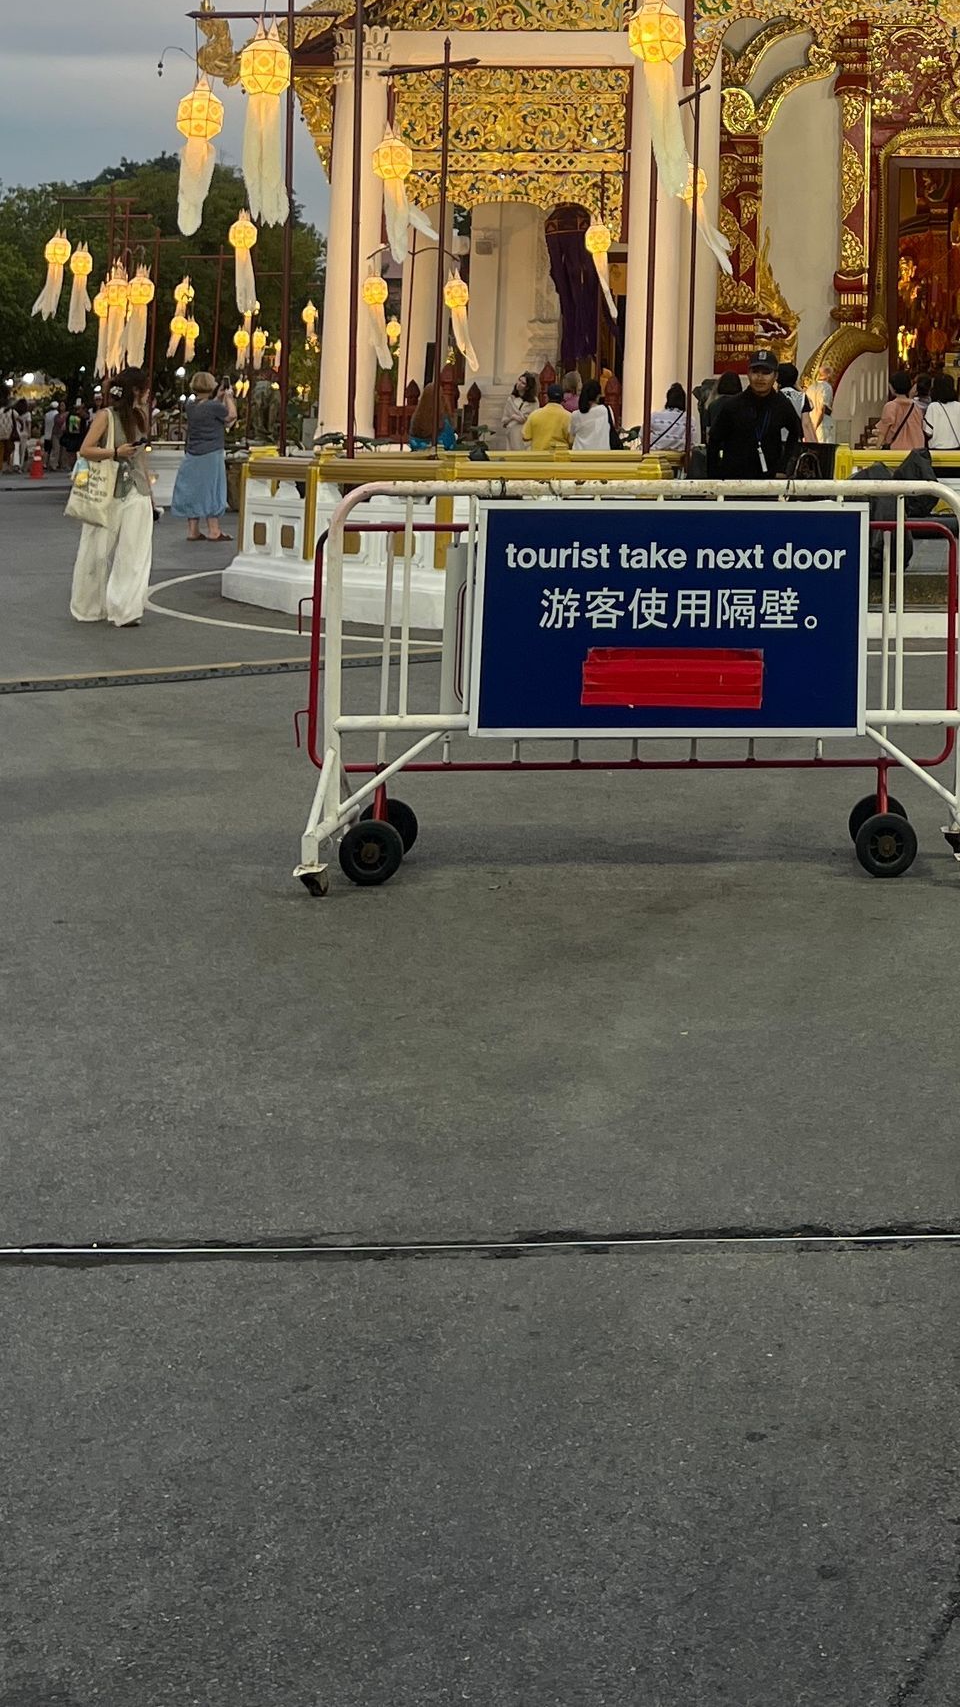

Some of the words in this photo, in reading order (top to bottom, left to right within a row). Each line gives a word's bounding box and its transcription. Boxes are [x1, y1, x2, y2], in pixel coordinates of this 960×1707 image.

[505, 541, 610, 569] tourist
[618, 541, 688, 569] take
[696, 545, 765, 570] next
[772, 542, 847, 570] door
[538, 586, 819, 630] 游客使用隔壁。
